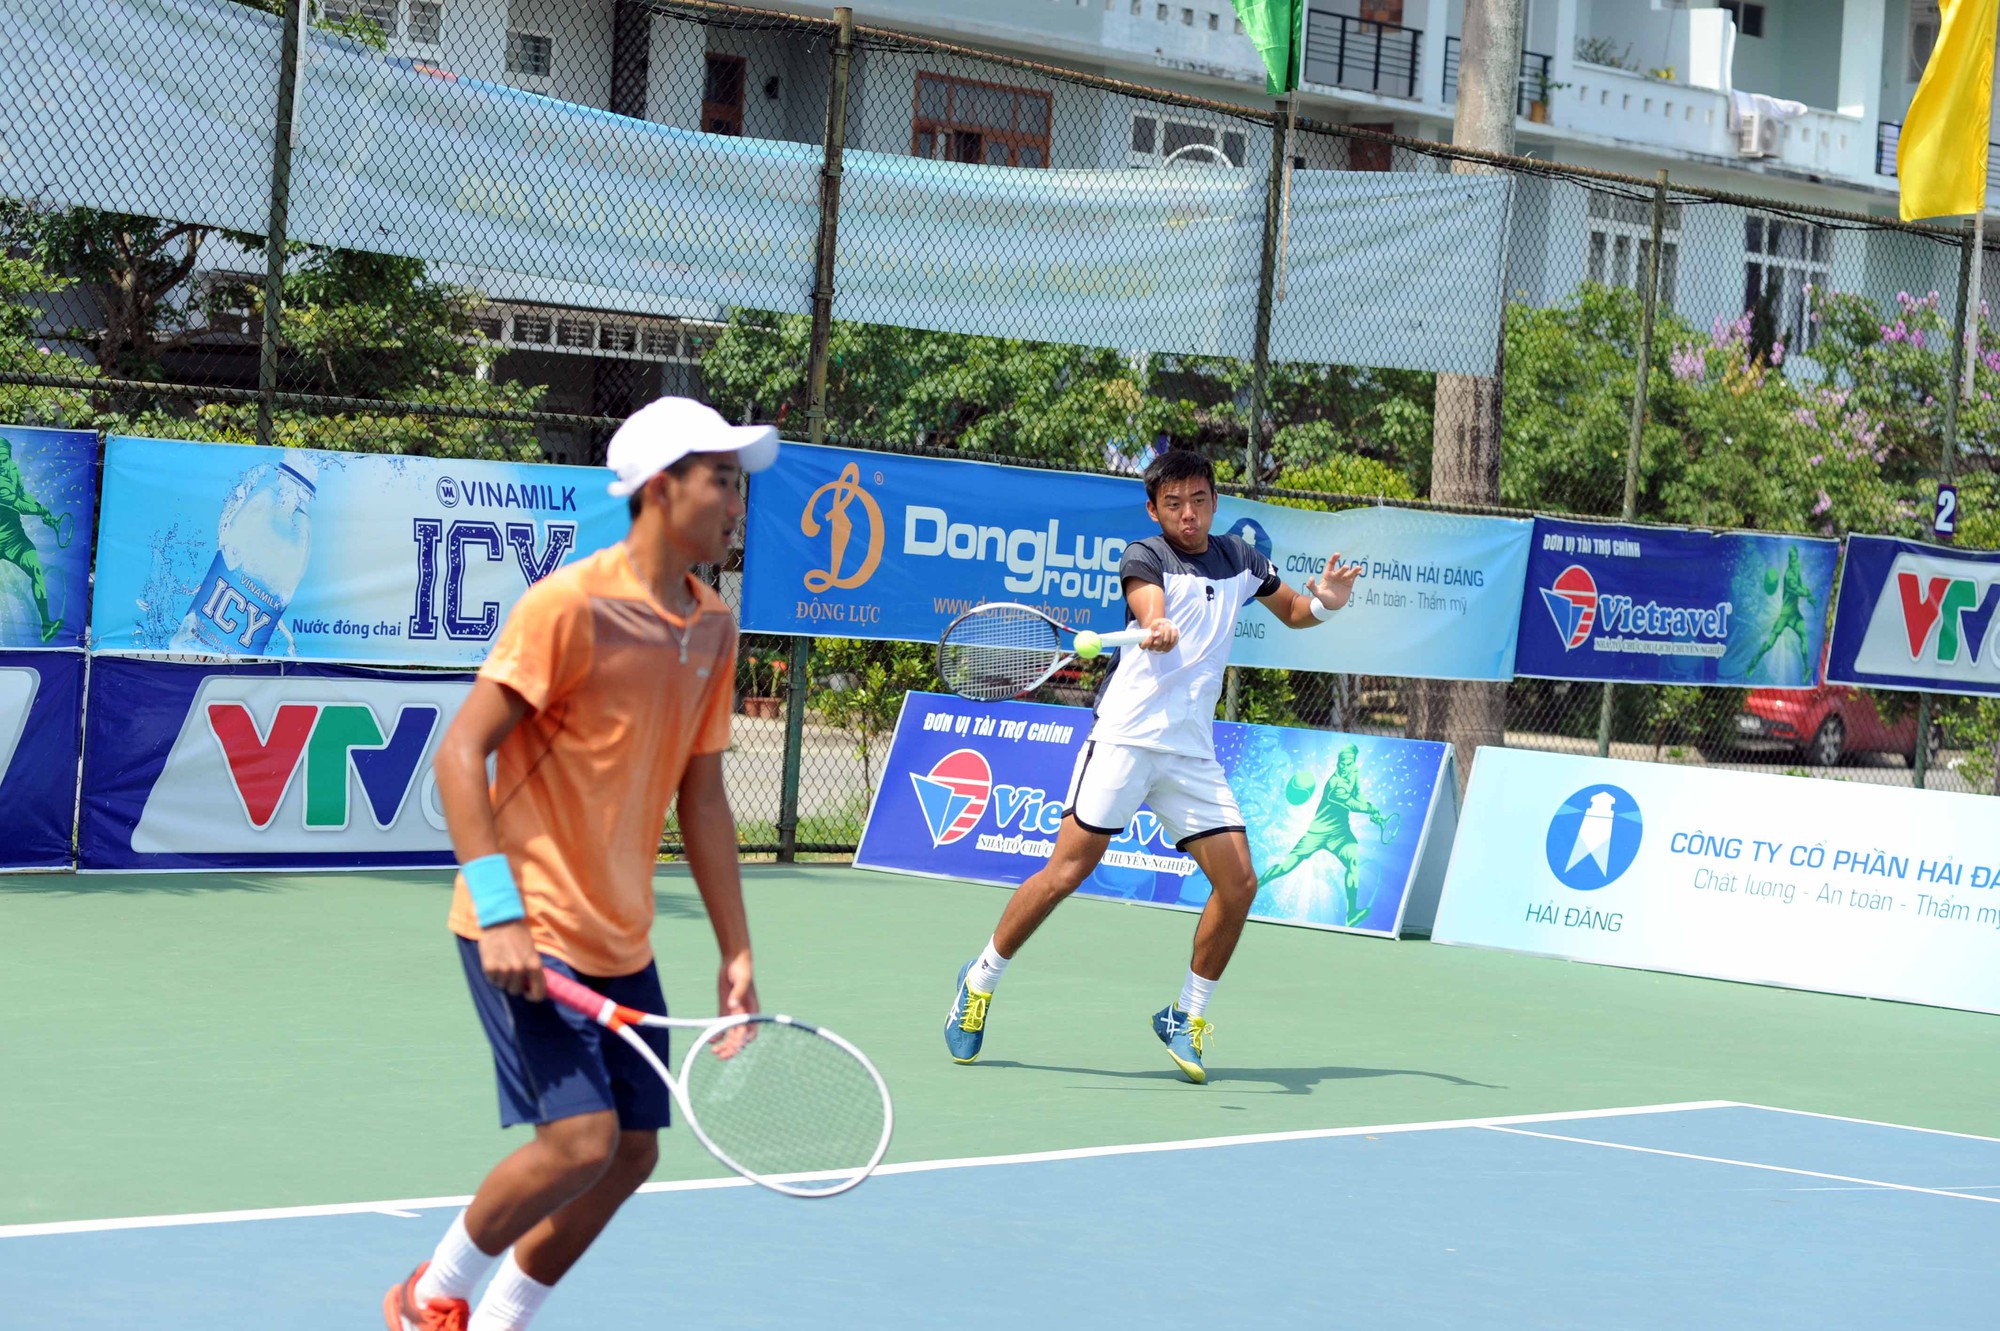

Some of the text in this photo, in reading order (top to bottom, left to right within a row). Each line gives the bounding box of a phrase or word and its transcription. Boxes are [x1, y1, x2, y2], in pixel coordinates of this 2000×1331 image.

[461, 480, 576, 511] VINAMILK
[1934, 490, 1955, 532] 2
[904, 505, 1128, 593] DongLuc
[408, 518, 575, 642] ICY
[1286, 552, 1326, 574] CÔNG
[1372, 558, 1412, 582] PHẦN
[1416, 561, 1440, 584] HẢI
[1444, 565, 1484, 587] ĐĂNG
[240, 575, 281, 611] VINAMILK
[1365, 588, 1380, 606] An
[1383, 590, 1406, 608] toàn
[201, 576, 272, 648] ICY
[292, 618, 401, 639] Nước đóng chai
[795, 597, 881, 627] ĐỘNG LỰC
[1599, 594, 1728, 638] Vietravel
[923, 712, 1074, 744] ĐƠN VỊ TÀI TRỢ CHÍNH
[1151, 856, 1197, 876] NGHIỆP
[1670, 829, 1742, 859] CÔNG
[1753, 840, 1783, 863] TY
[1789, 840, 1827, 868] CỔ
[1833, 847, 1909, 879] PHẦN
[1917, 855, 1963, 886] HẢI
[1525, 899, 1623, 932] HẢI ĐĂNG
[1816, 882, 1843, 905] An
[1849, 888, 1893, 912] toàn
[1917, 893, 1970, 921] Thẩm
